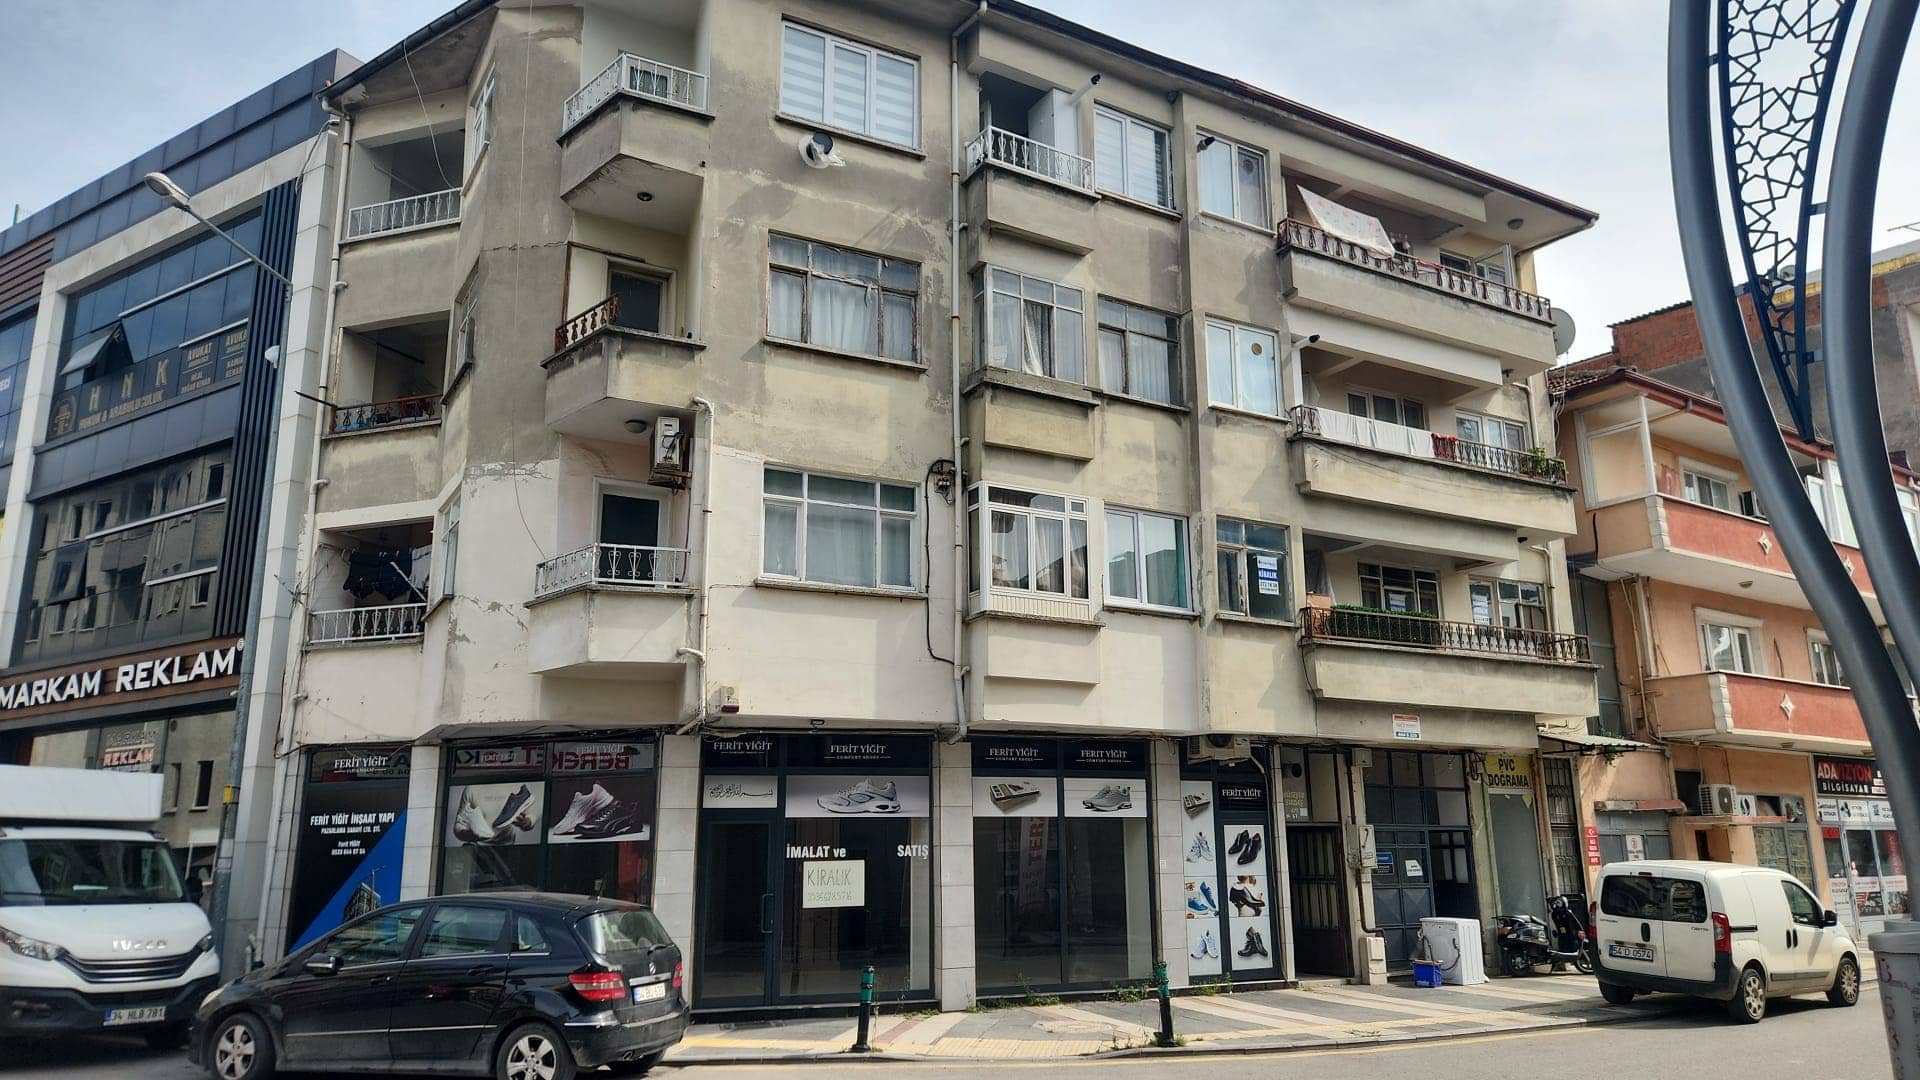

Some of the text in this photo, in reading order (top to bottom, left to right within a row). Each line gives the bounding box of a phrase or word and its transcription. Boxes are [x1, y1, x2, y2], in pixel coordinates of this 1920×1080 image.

[0, 646, 235, 710] MARKAM REKLAM
[713, 740, 773, 750] FERİT YİĞİT
[830, 743, 887, 754] FERİT YİĞİT
[103, 749, 154, 766] REKLAM
[989, 747, 1039, 757] FERİT YİĞİT
[1081, 749, 1128, 758] FERİT YİĞİT
[334, 755, 389, 769] FERİT YİĞİT
[1498, 758, 1515, 771] PVC
[310, 812, 395, 826] FERİT YİĞİT İNŞAAT YAPI
[786, 844, 929, 860] İMALAT ve SATIŞ
[112, 940, 167, 952] IVECO
